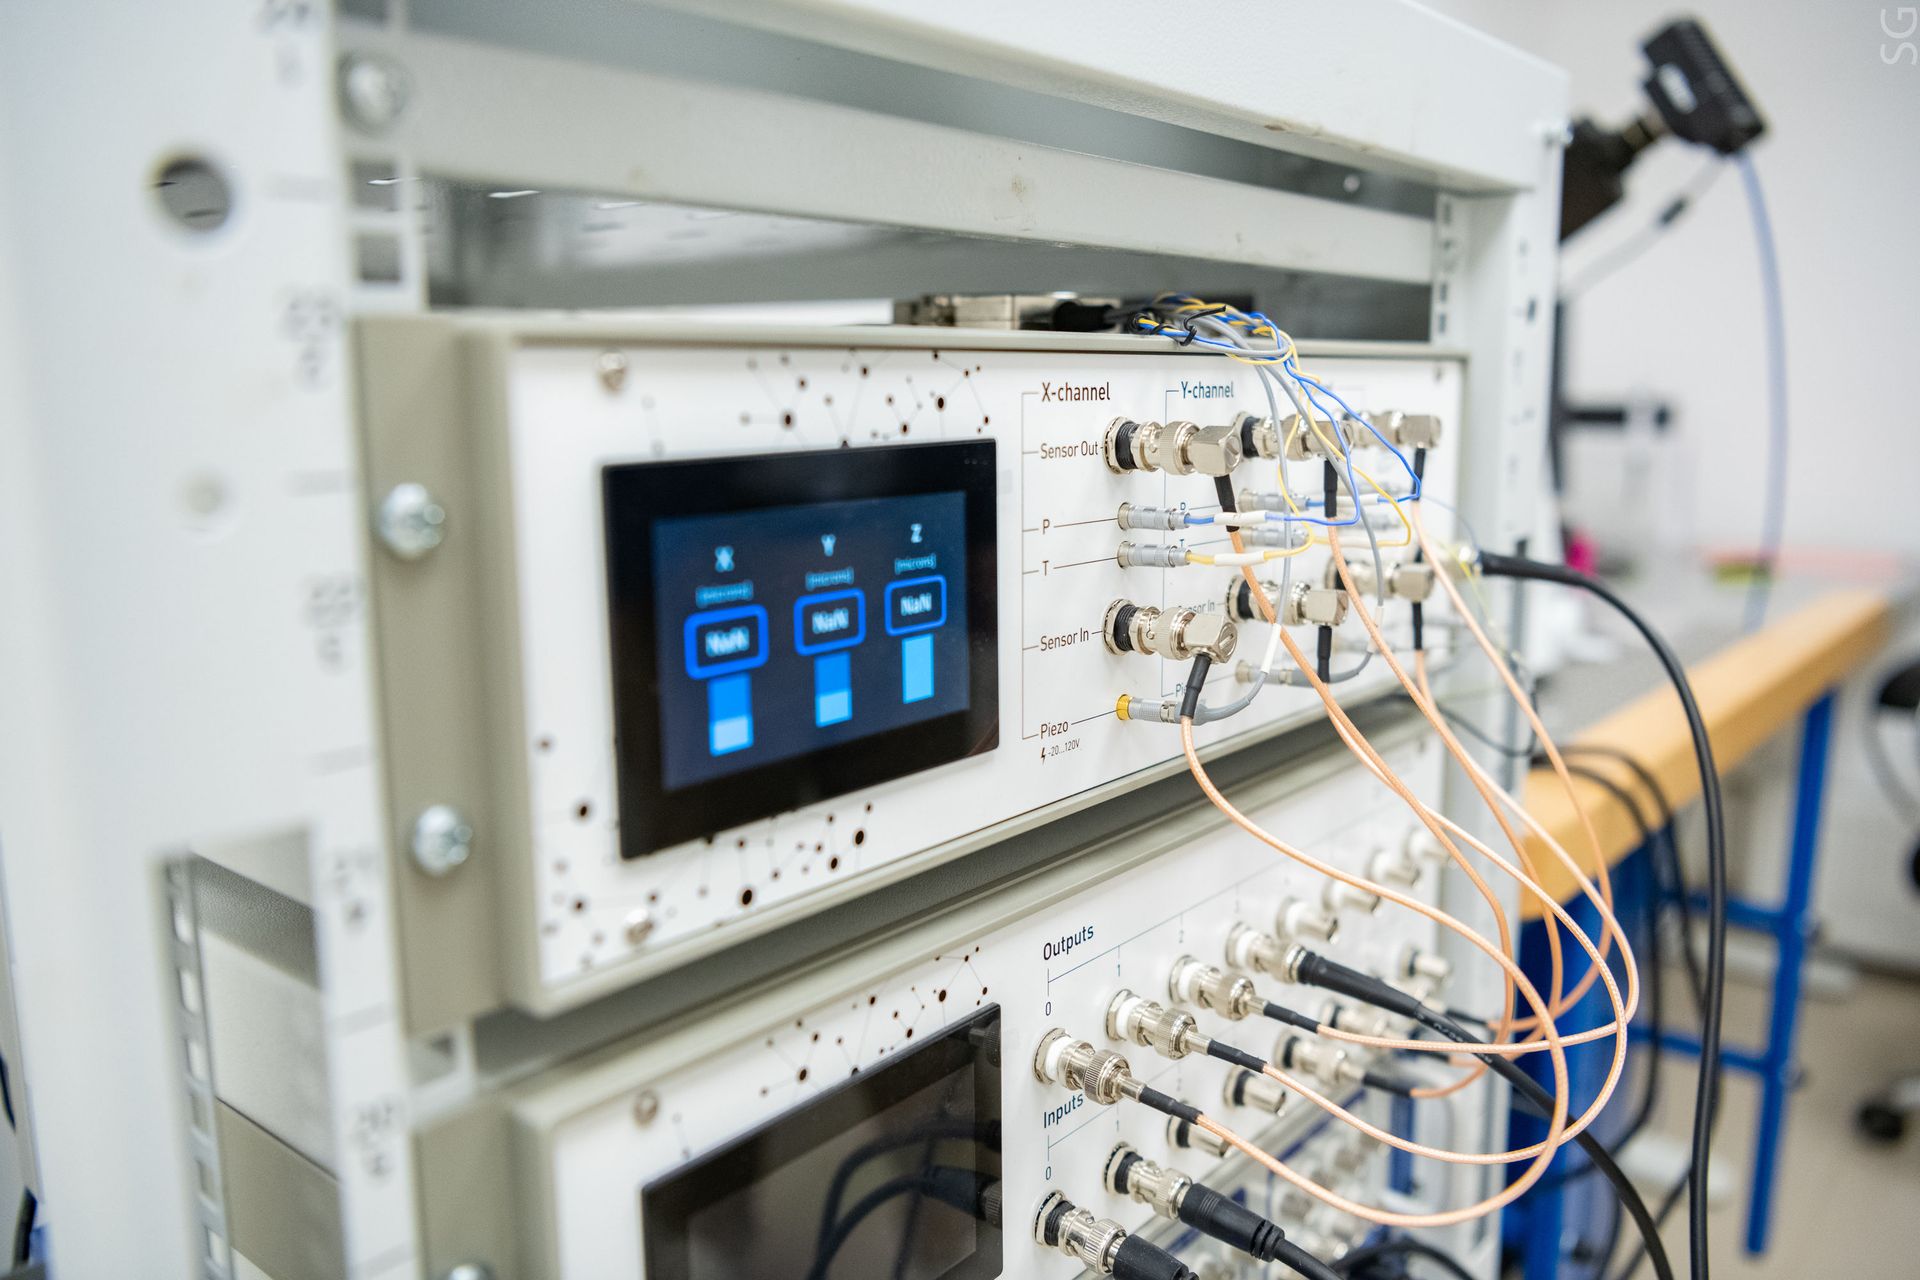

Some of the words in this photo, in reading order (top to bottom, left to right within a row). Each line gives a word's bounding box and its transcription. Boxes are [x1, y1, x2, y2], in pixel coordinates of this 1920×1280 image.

[1041, 382, 1111, 402] X-channel
[1181, 381, 1235, 399] Y-channel
[1039, 443, 1079, 460] Sensor
[1080, 440, 1099, 456] Out
[910, 523, 923, 543] Z
[1041, 518, 1051, 535] P
[820, 533, 837, 557] Y
[714, 545, 735, 572] X
[1041, 560, 1050, 576] T
[901, 593, 931, 615] NaN
[812, 608, 849, 634] NaN
[1040, 633, 1077, 652] Sensor
[1079, 627, 1090, 643] In
[1040, 721, 1069, 739] Piezo
[1043, 924, 1095, 961] Outputs
[1045, 1001, 1052, 1017] 0
[1043, 1093, 1084, 1129] Inputs
[1045, 1166, 1052, 1180] 0
